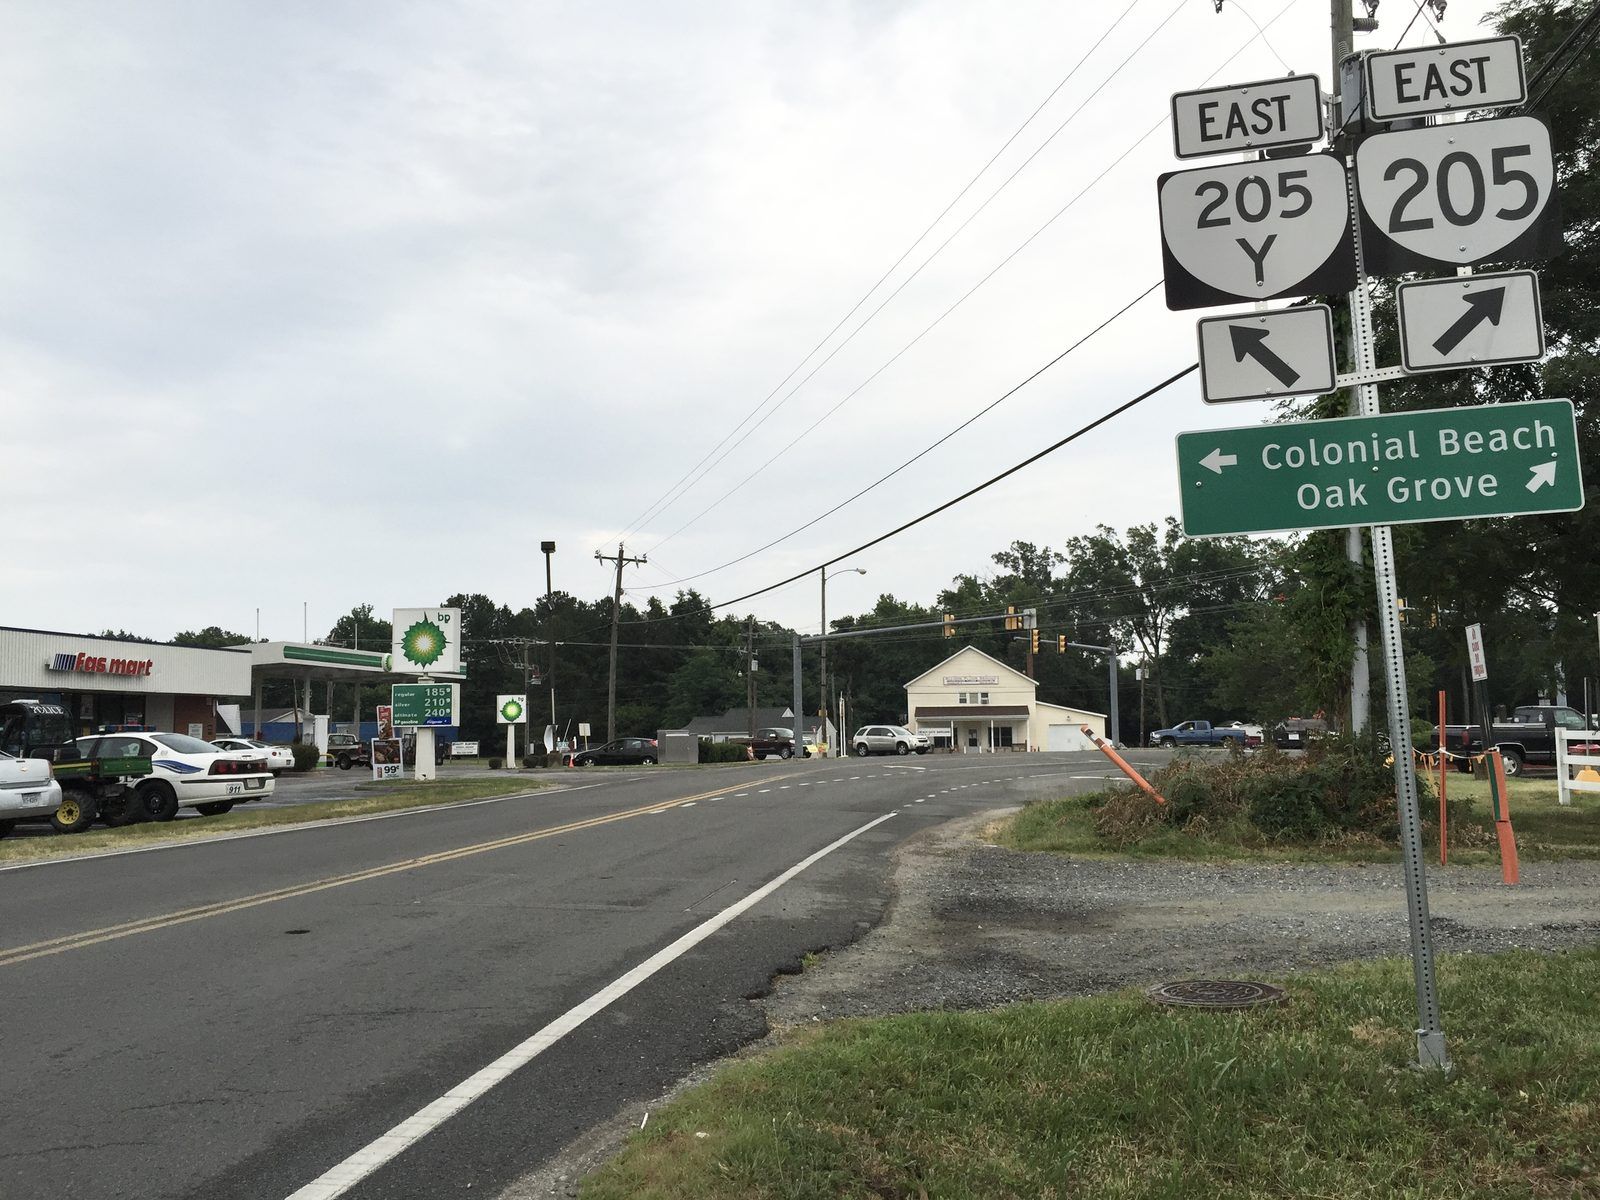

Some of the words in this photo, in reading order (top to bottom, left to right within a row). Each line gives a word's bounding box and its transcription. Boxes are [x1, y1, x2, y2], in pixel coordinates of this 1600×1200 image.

[1394, 56, 1491, 104] EAST
[1199, 95, 1291, 143] EAST
[1194, 170, 1313, 229] 205
[1384, 145, 1539, 234] 205
[1235, 234, 1278, 283] Y
[1262, 431, 1420, 470] Colonial
[1438, 420, 1556, 456] Beach
[1297, 478, 1368, 510] Oak
[1387, 472, 1499, 504] Grove
[437, 612, 451, 624] bp
[109, 658, 153, 676] mart
[30, 706, 64, 715] POLICE
[228, 785, 241, 795] 911
